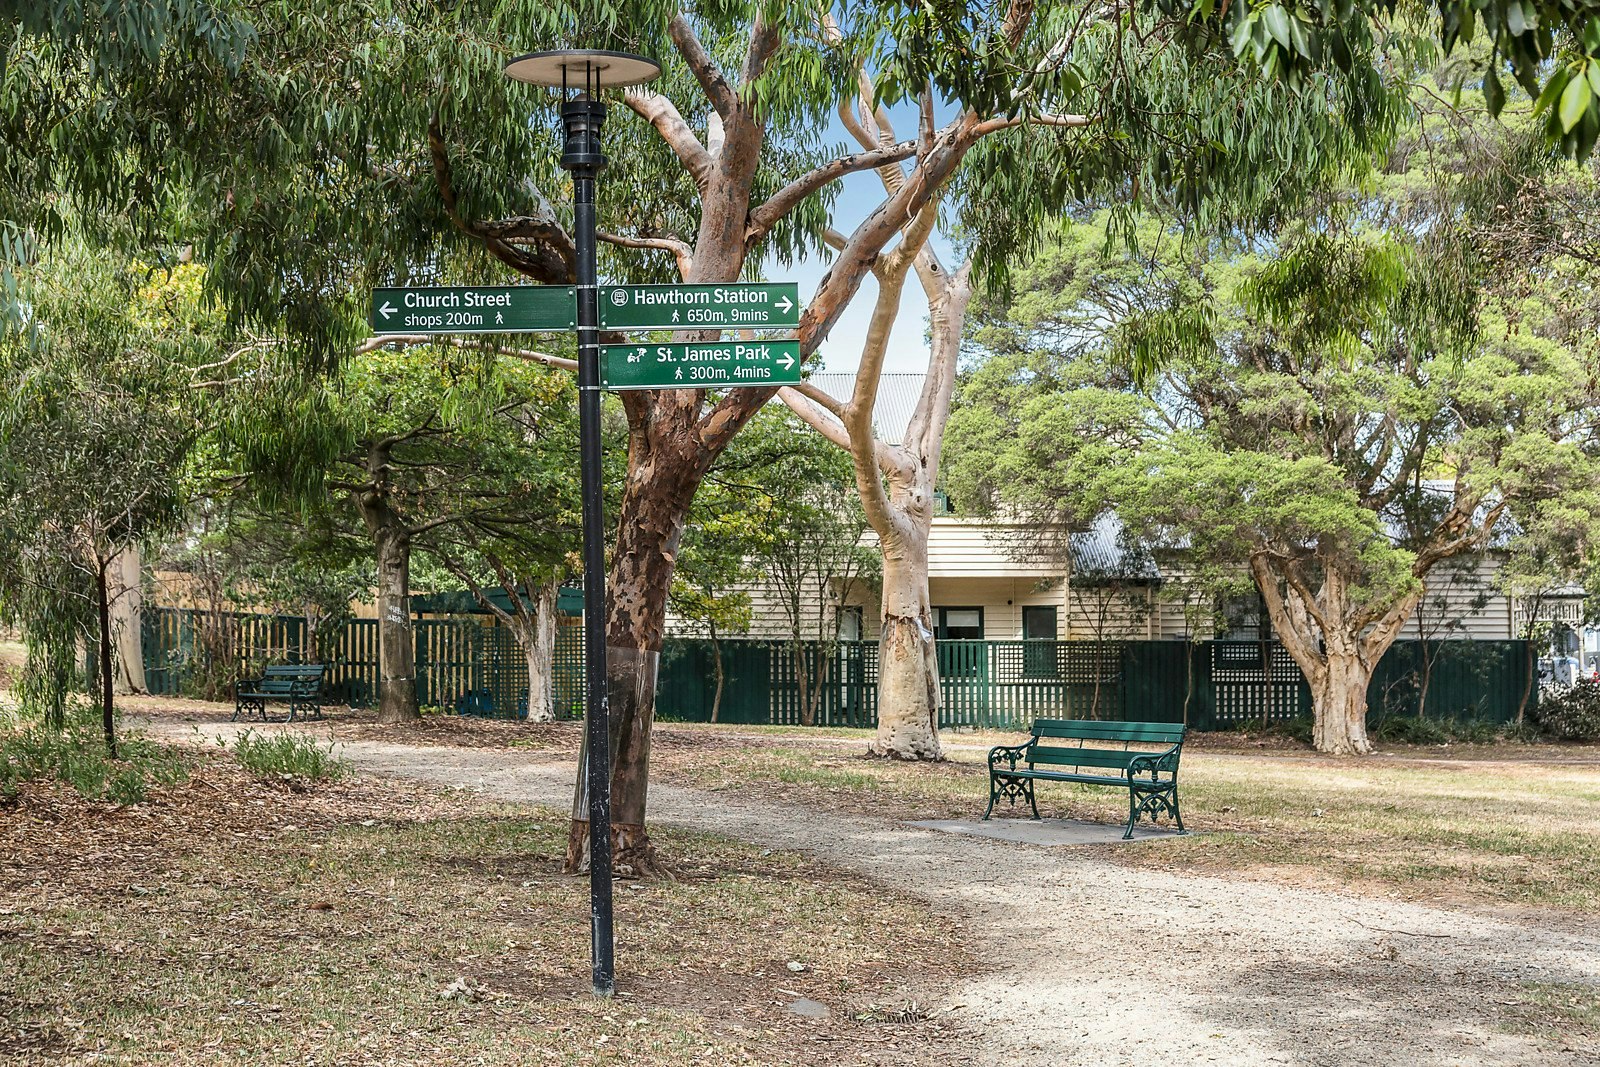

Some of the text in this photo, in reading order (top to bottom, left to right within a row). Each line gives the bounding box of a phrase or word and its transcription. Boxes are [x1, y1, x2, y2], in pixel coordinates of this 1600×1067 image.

[404, 291, 512, 308] Church Street
[634, 288, 768, 305] Hawthorn Station
[404, 312, 483, 328] shops 200m
[687, 308, 769, 323] 650m, 9mins
[656, 345, 771, 362] St. James Park
[689, 365, 771, 380] 300m, 4mins
